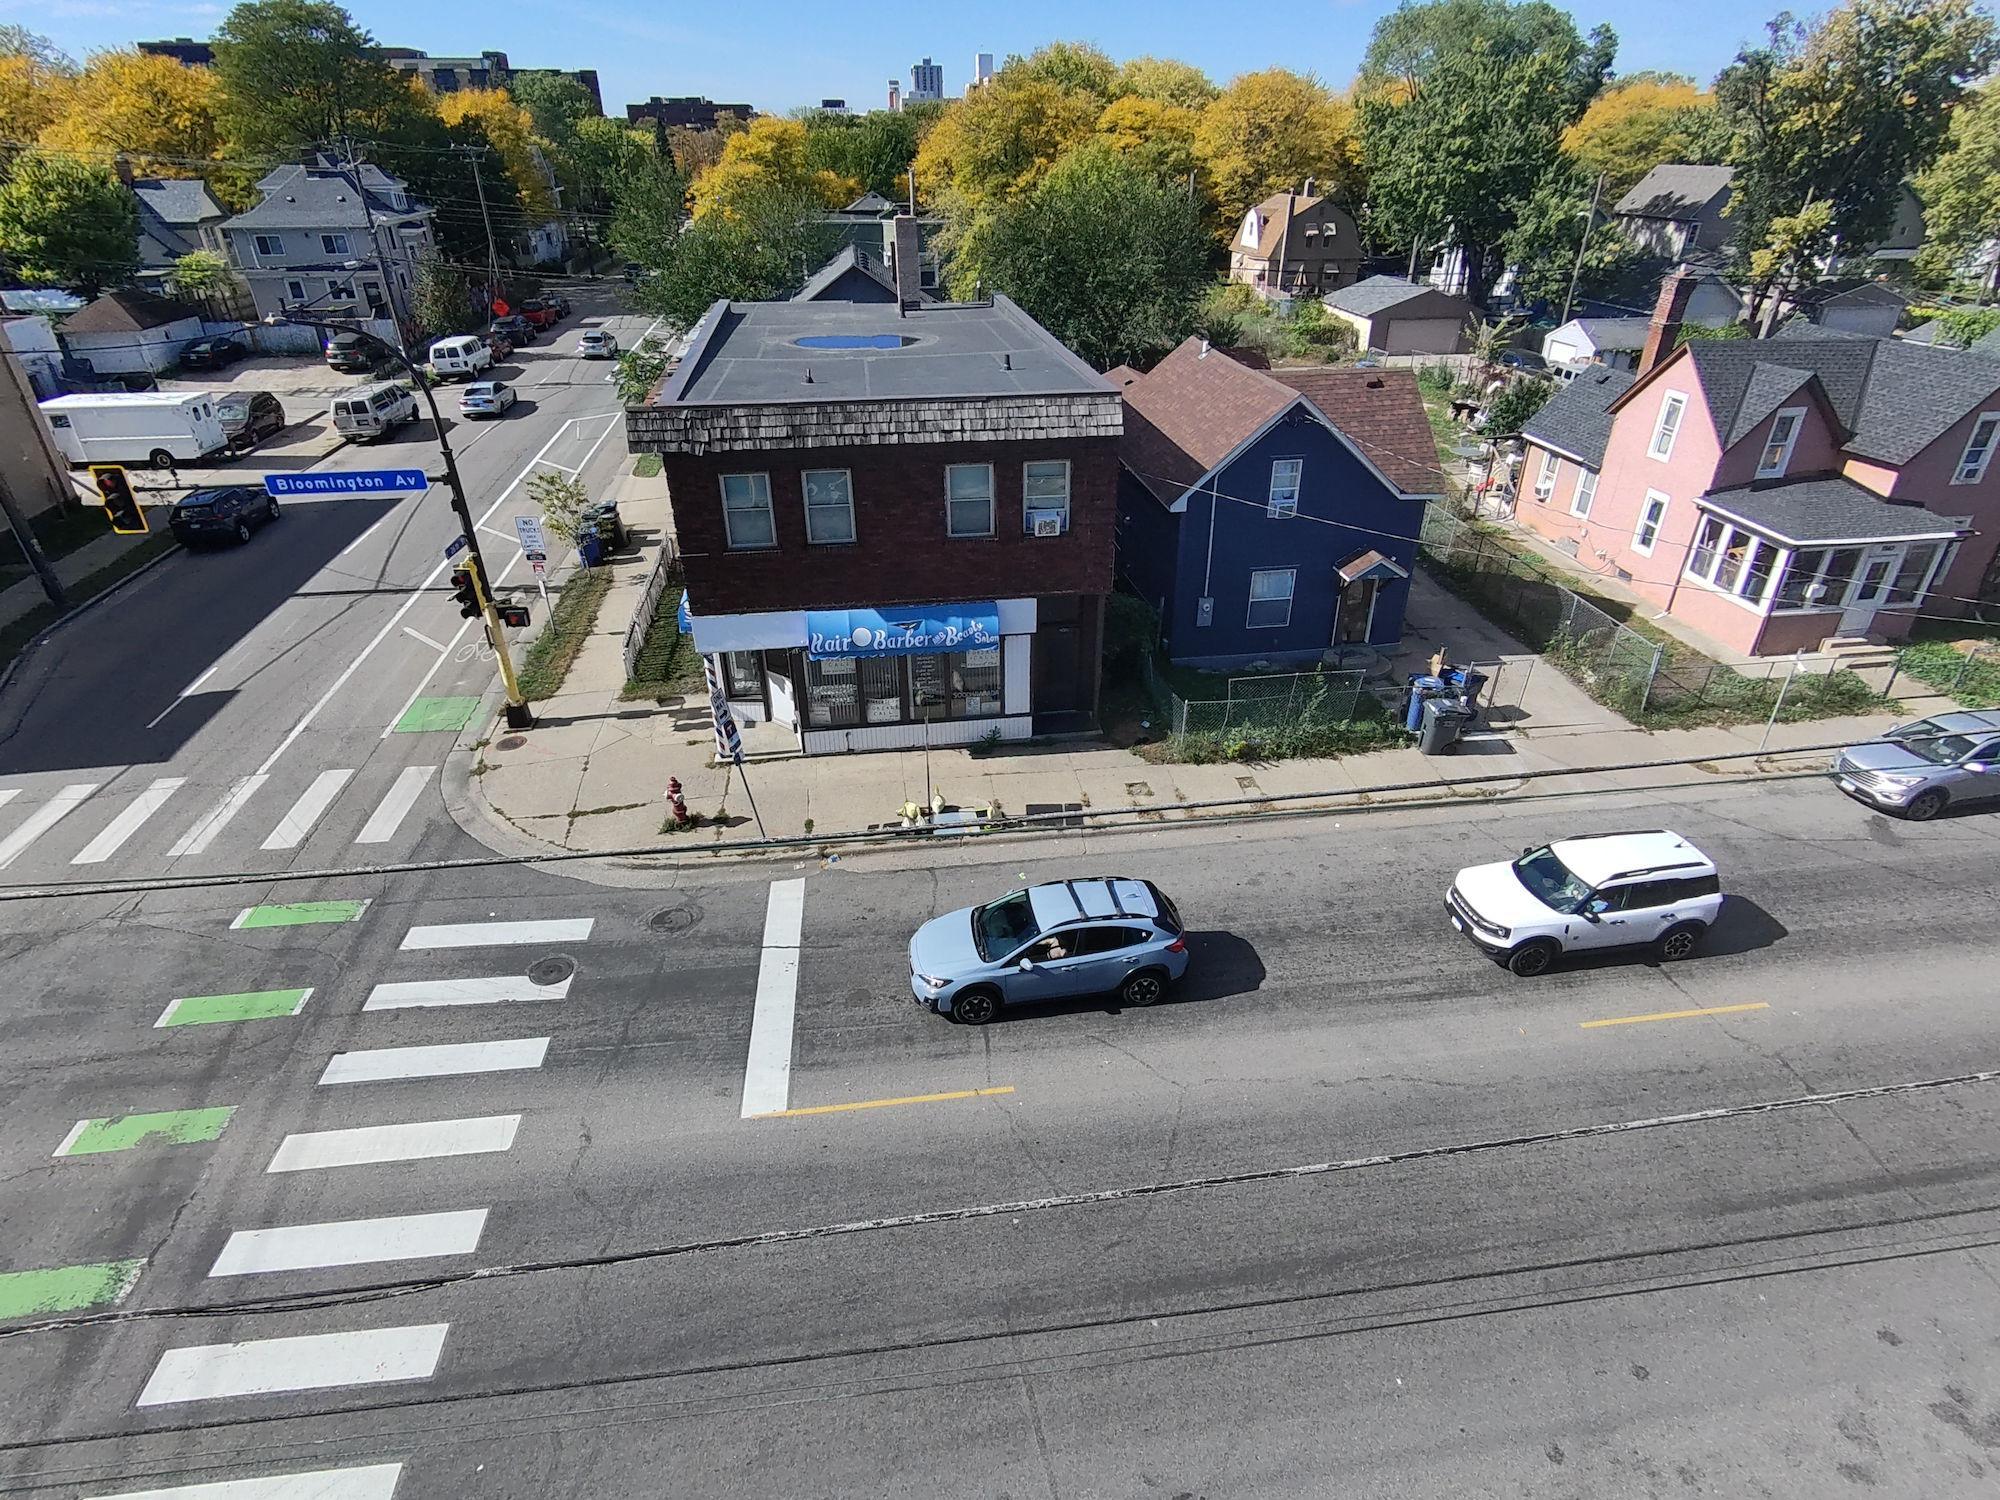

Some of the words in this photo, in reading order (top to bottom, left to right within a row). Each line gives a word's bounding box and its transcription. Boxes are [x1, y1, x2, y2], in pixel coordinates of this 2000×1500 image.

[276, 477, 384, 491] Bloomington
[395, 474, 416, 487] Av
[810, 632, 851, 653] Hair
[873, 629, 932, 650] Barber
[944, 620, 983, 647] Beauty
